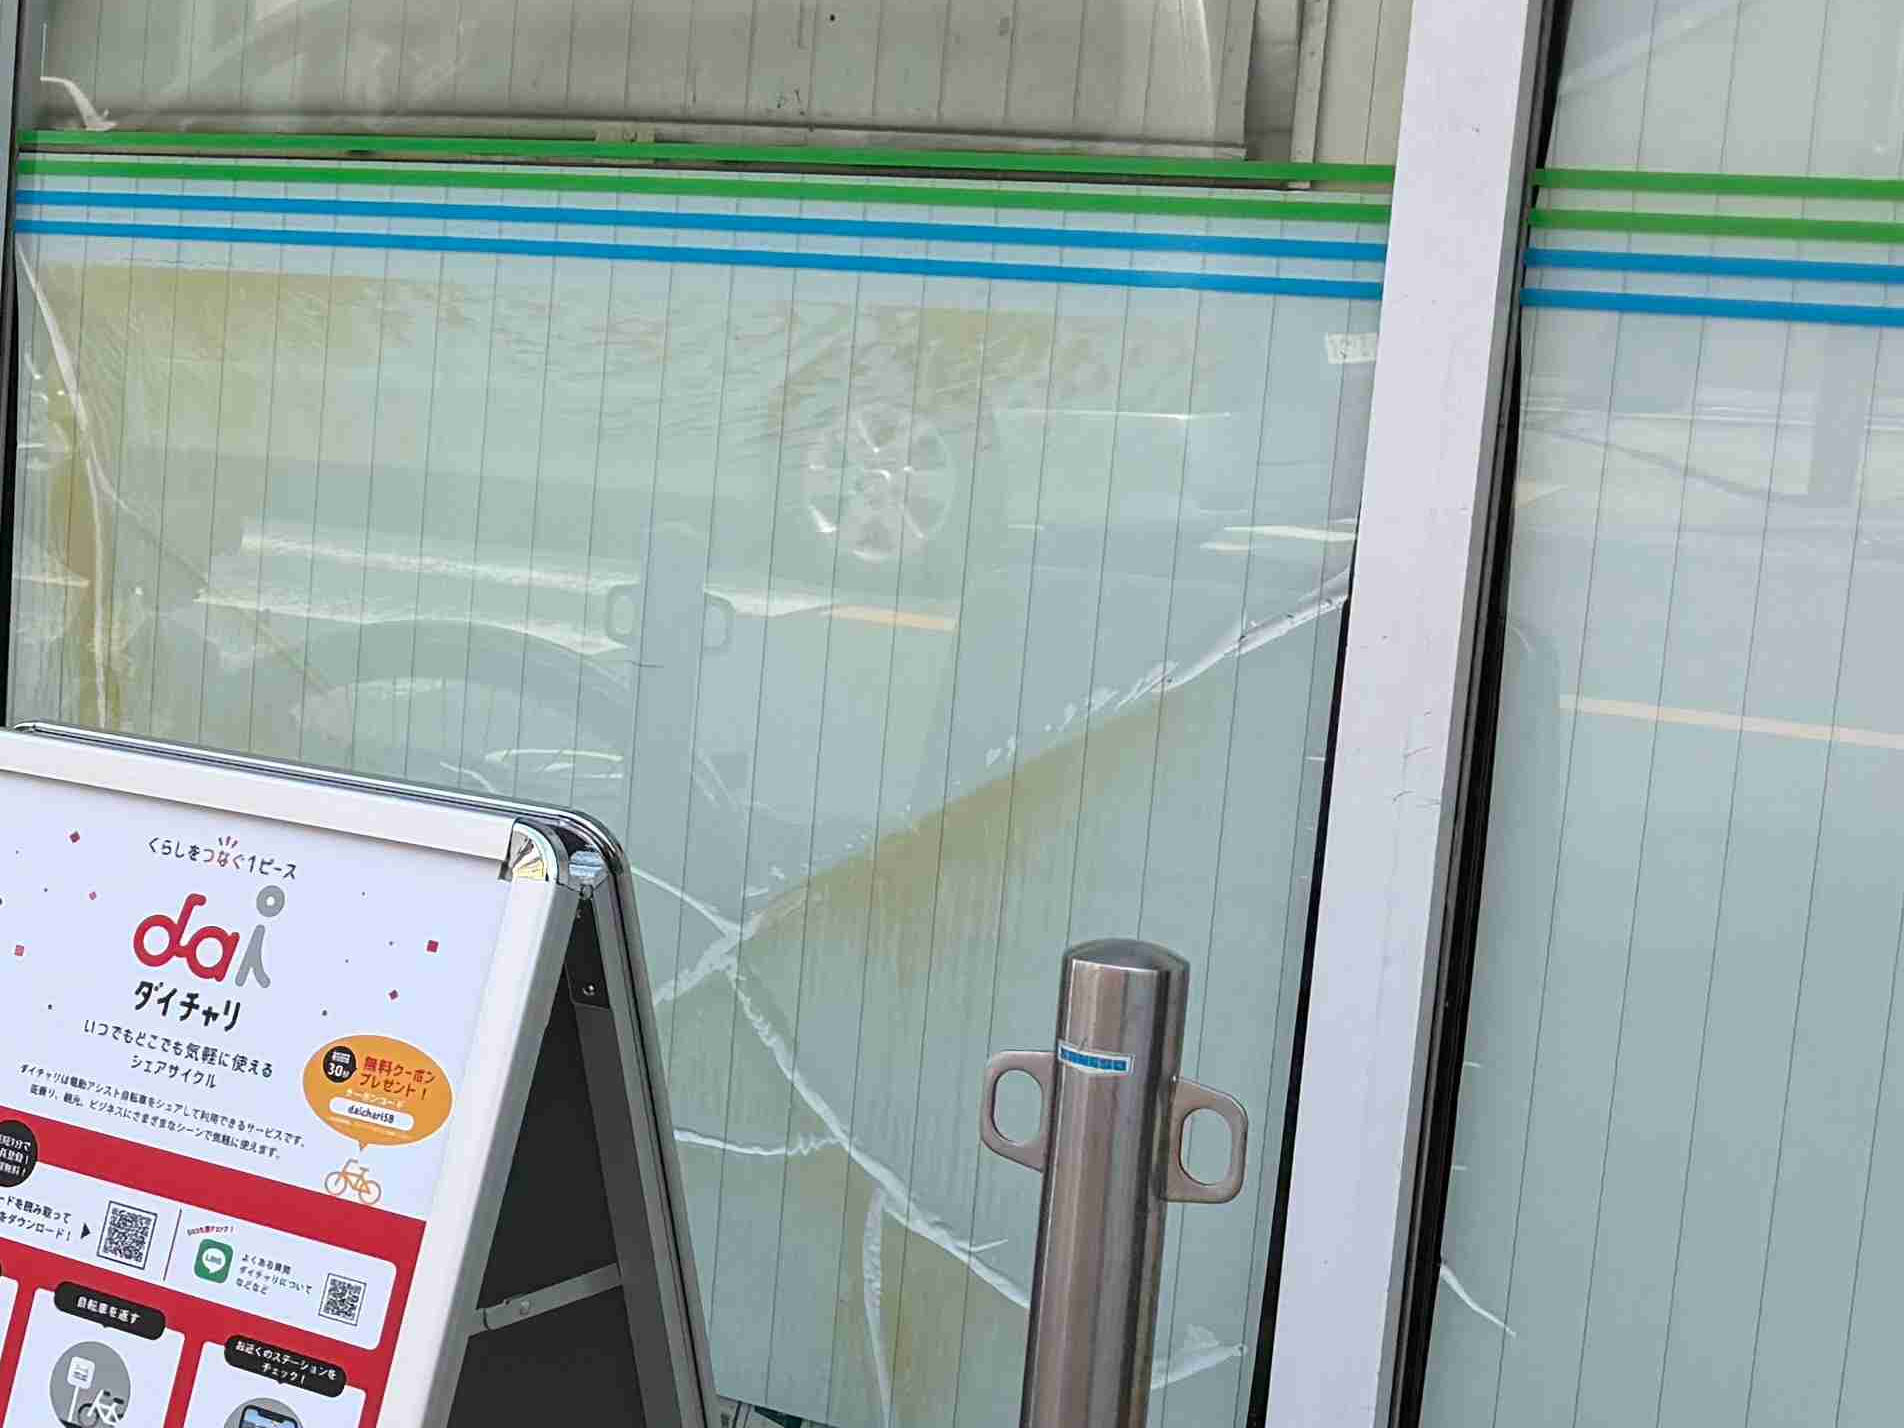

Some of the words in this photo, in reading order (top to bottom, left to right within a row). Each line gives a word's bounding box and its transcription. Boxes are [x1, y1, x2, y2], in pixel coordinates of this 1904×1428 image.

[147, 837, 297, 880] くらしをつなぐ1ピース
[133, 885, 285, 988] dai
[134, 980, 242, 1031] ダイチャリ
[83, 1018, 273, 1079] いつでもどこでも気軽に使える
[130, 1055, 218, 1090] シェアサイクル
